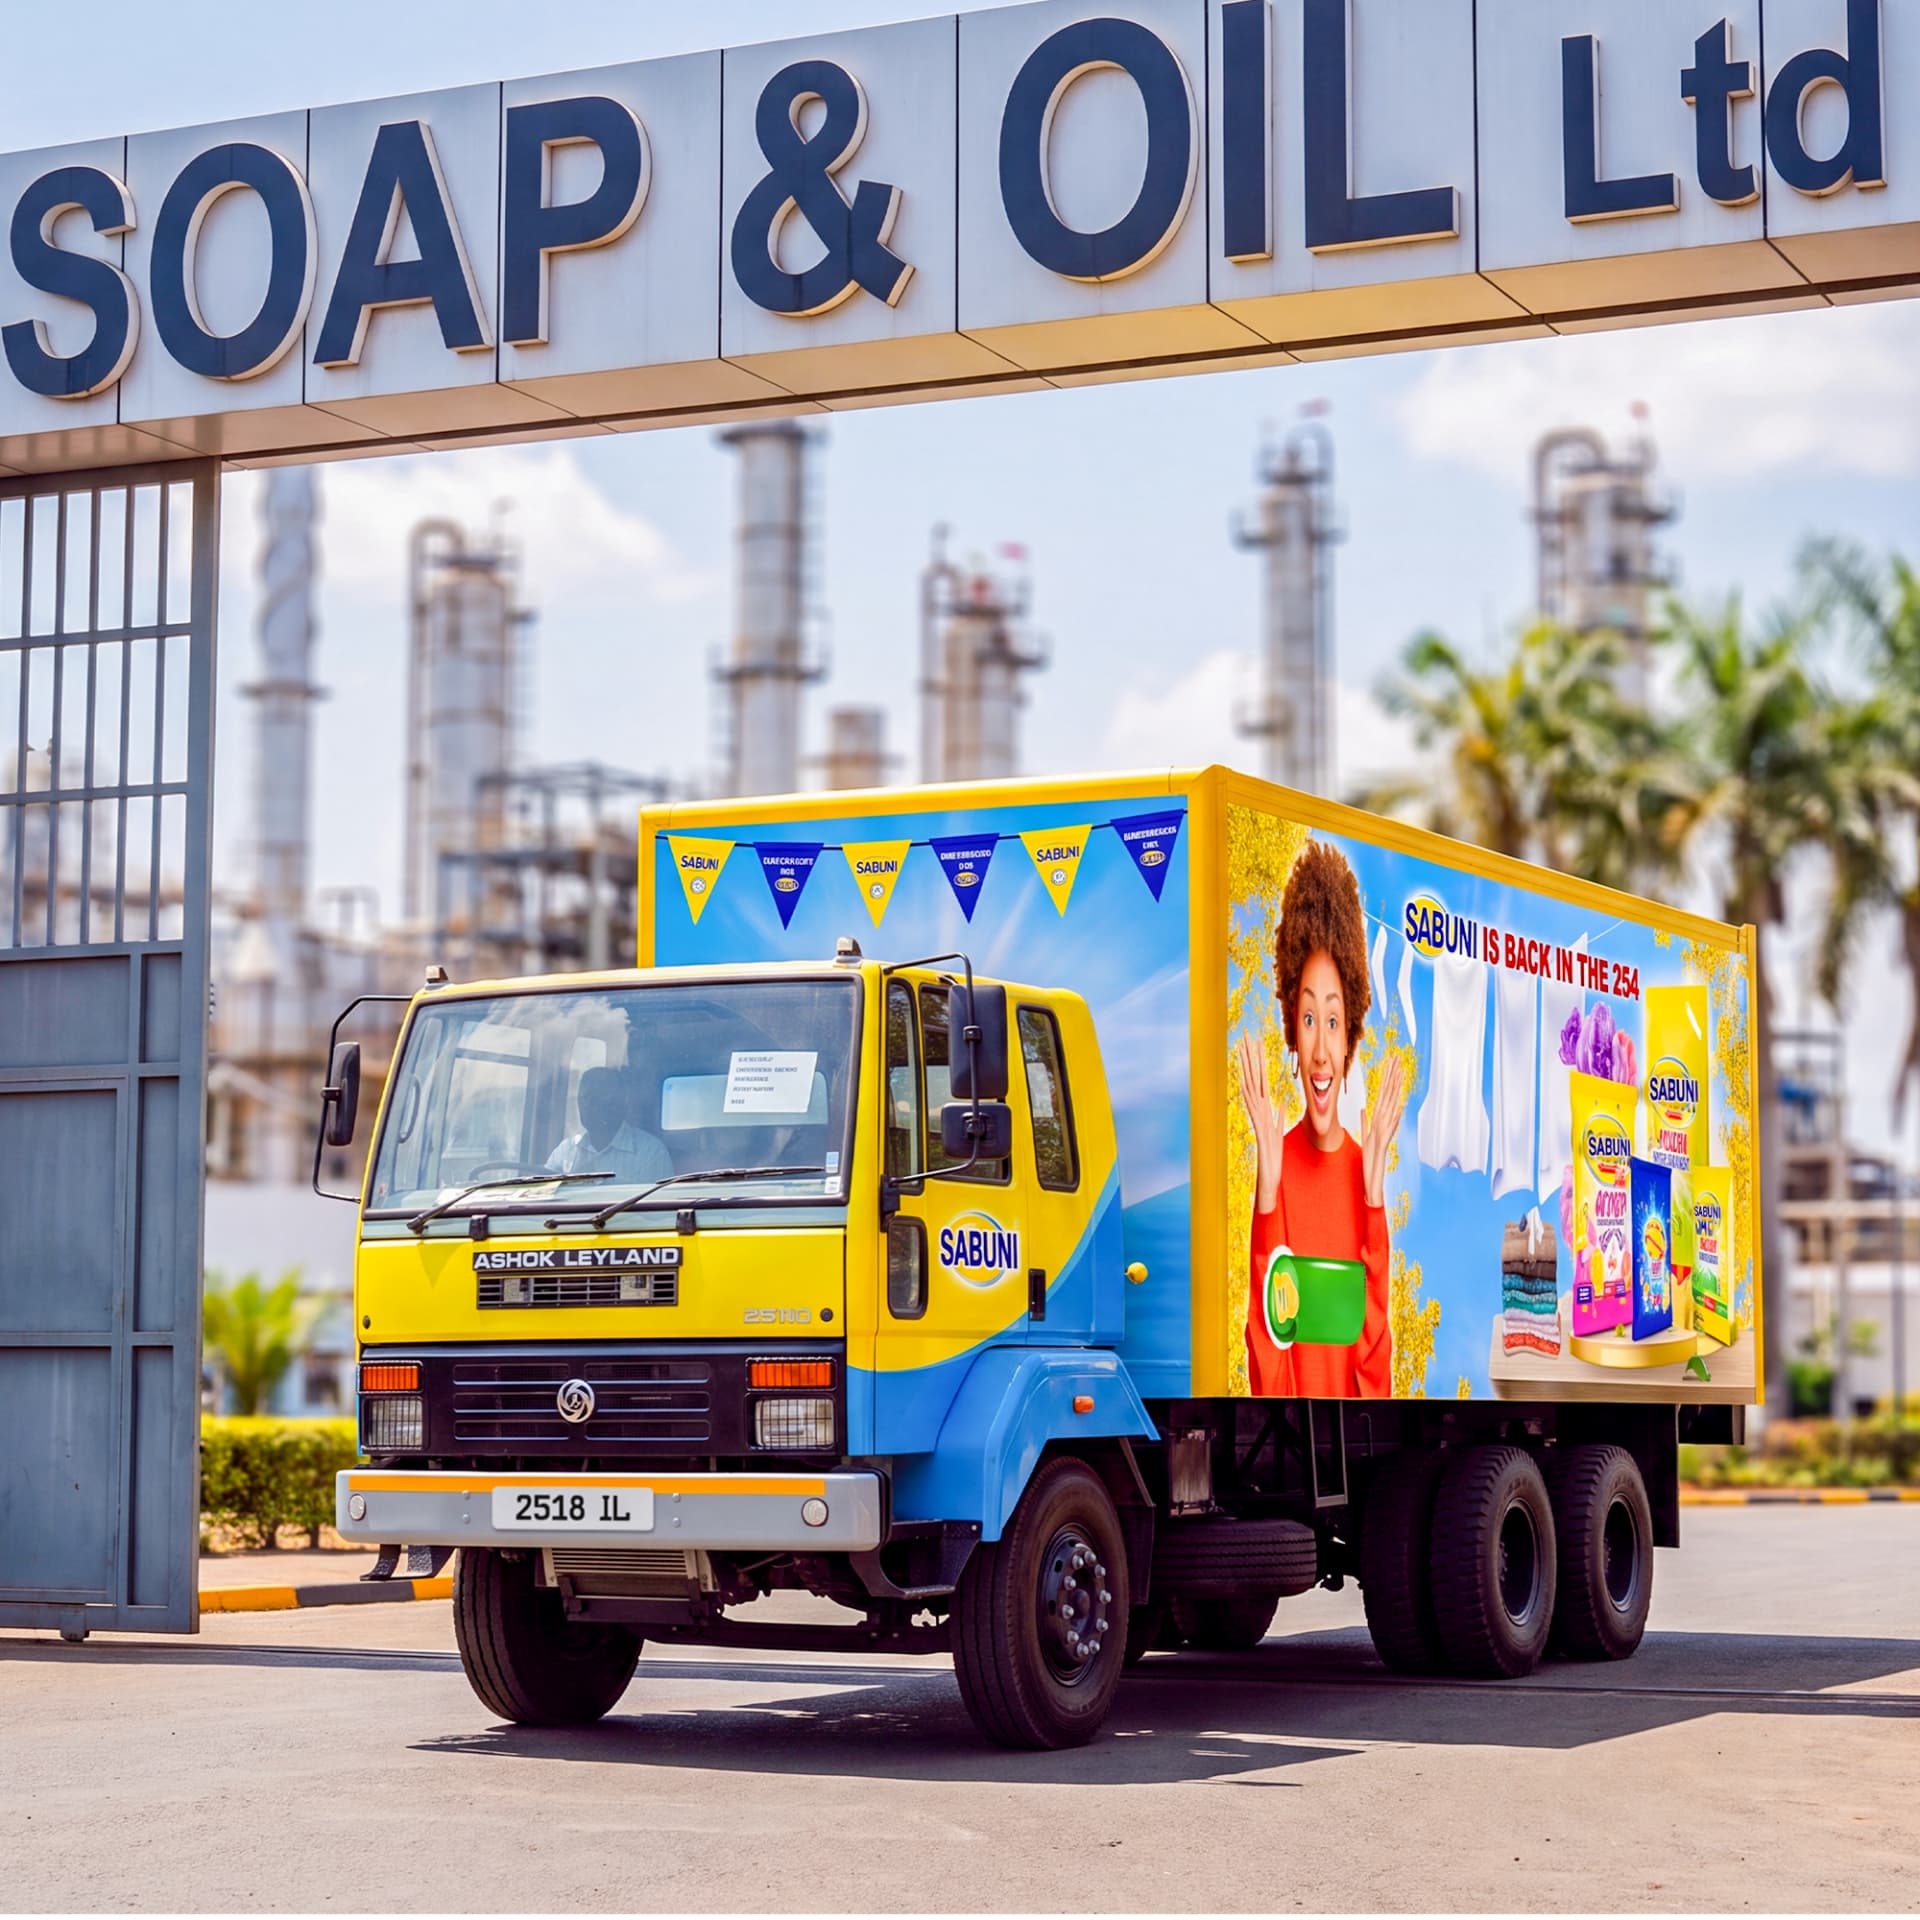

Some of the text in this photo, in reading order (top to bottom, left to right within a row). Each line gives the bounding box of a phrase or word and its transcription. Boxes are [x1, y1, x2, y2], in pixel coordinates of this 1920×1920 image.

[1, 0, 1888, 400] SOAP & OIL Ltd
[680, 854, 719, 871] SABUNI
[1036, 845, 1080, 863] SABUNI
[855, 860, 898, 874] SABUNI
[1405, 902, 1640, 1001] SABUNI IS BACK IN THE 254
[1649, 1076, 1699, 1103] SABUNI
[1588, 1136, 1631, 1157] SABUNI
[1694, 1205, 1721, 1219] SABUNI
[474, 1247, 680, 1269] ASHOK LEYLAND
[940, 1228, 1018, 1269] SABUNI
[515, 1494, 631, 1521] 2518 IL
